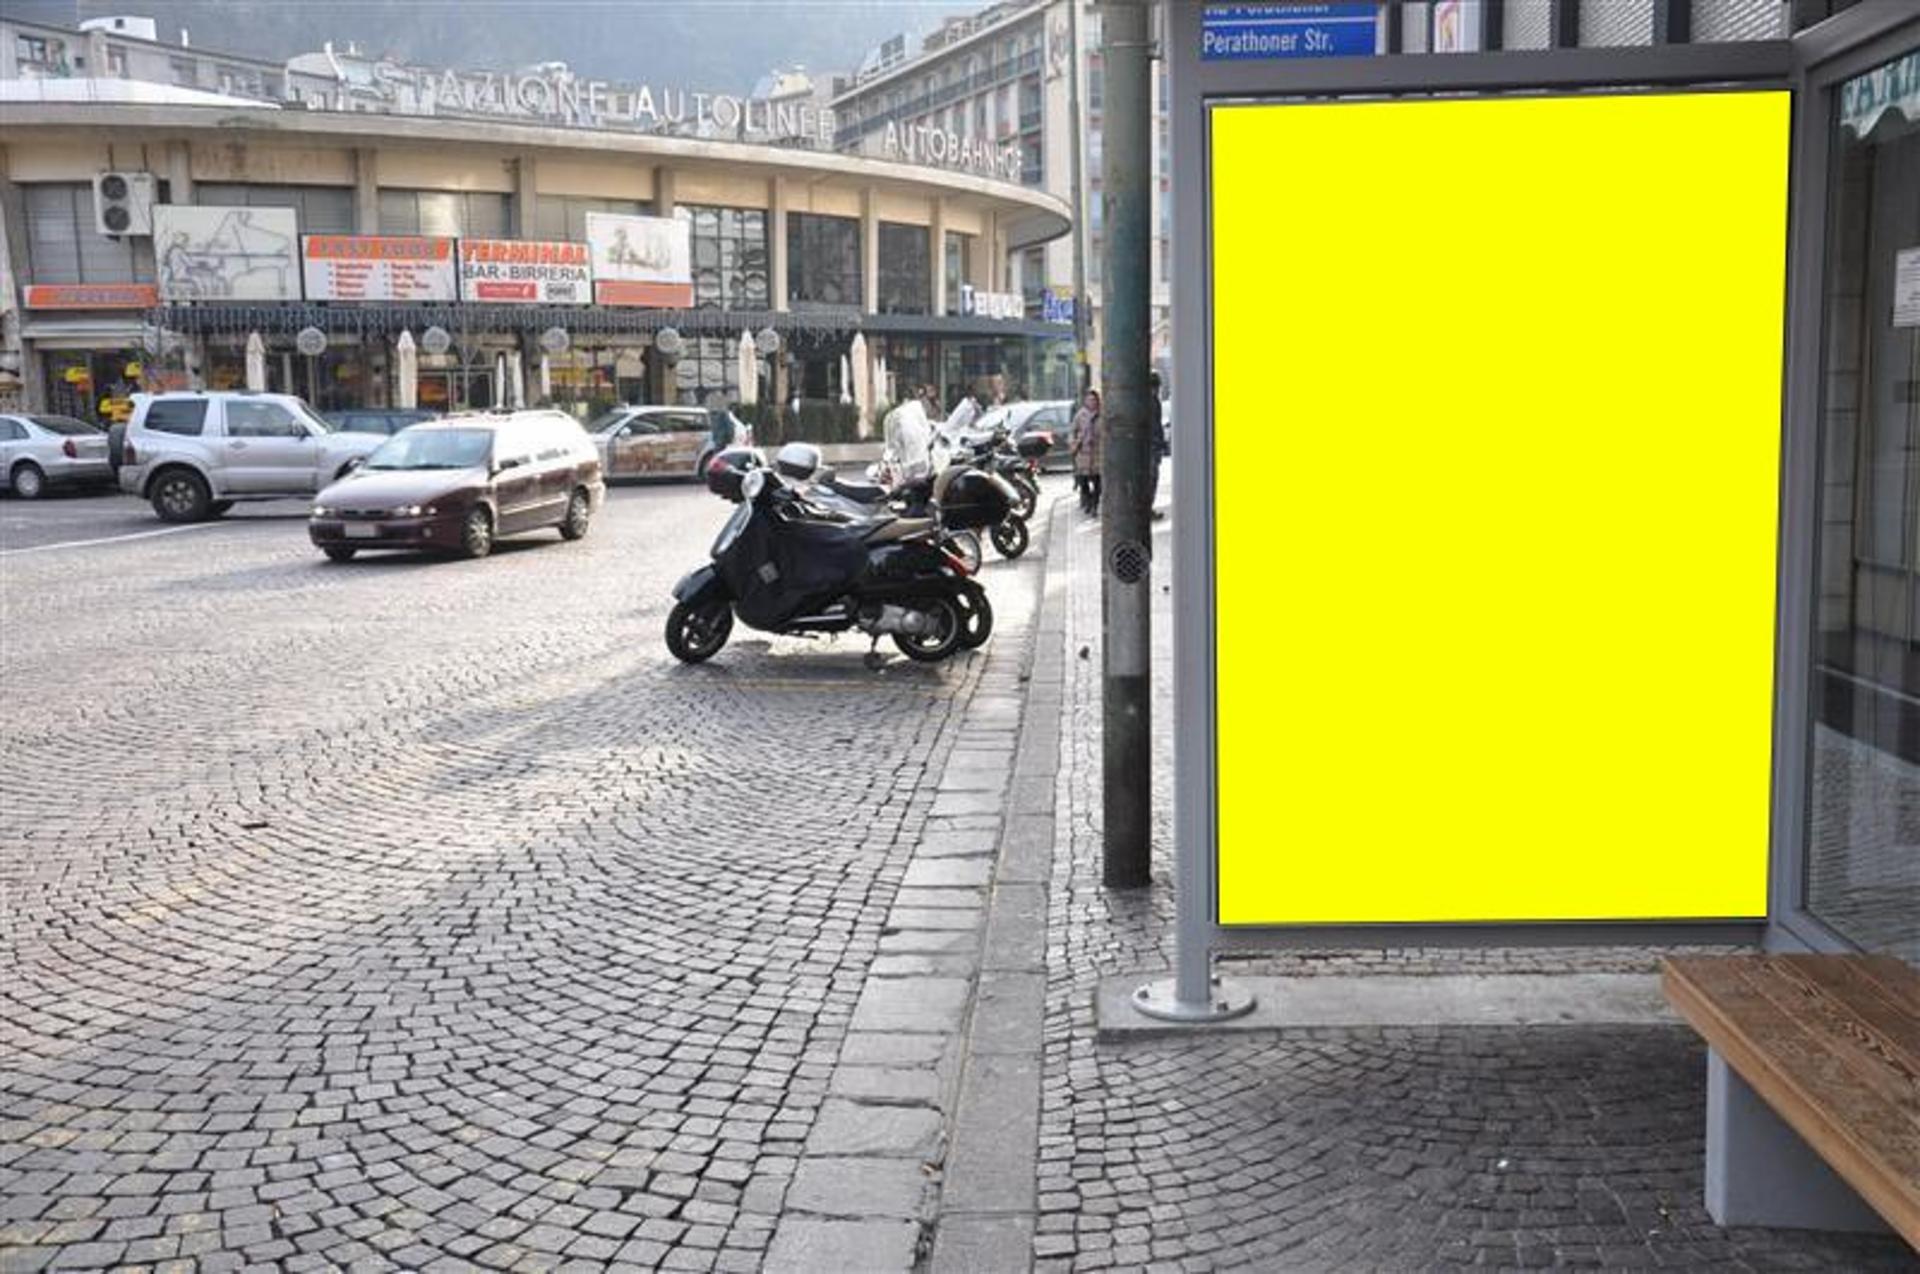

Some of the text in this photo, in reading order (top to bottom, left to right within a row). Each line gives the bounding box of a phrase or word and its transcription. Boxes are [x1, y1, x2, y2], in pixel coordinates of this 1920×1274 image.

[1203, 27, 1334, 53] Perathoner Str.
[373, 60, 836, 142] STAZIONE AUTOLINEE
[884, 119, 1023, 176] AUTOBAHNHOF
[461, 240, 587, 265] TERMINAL
